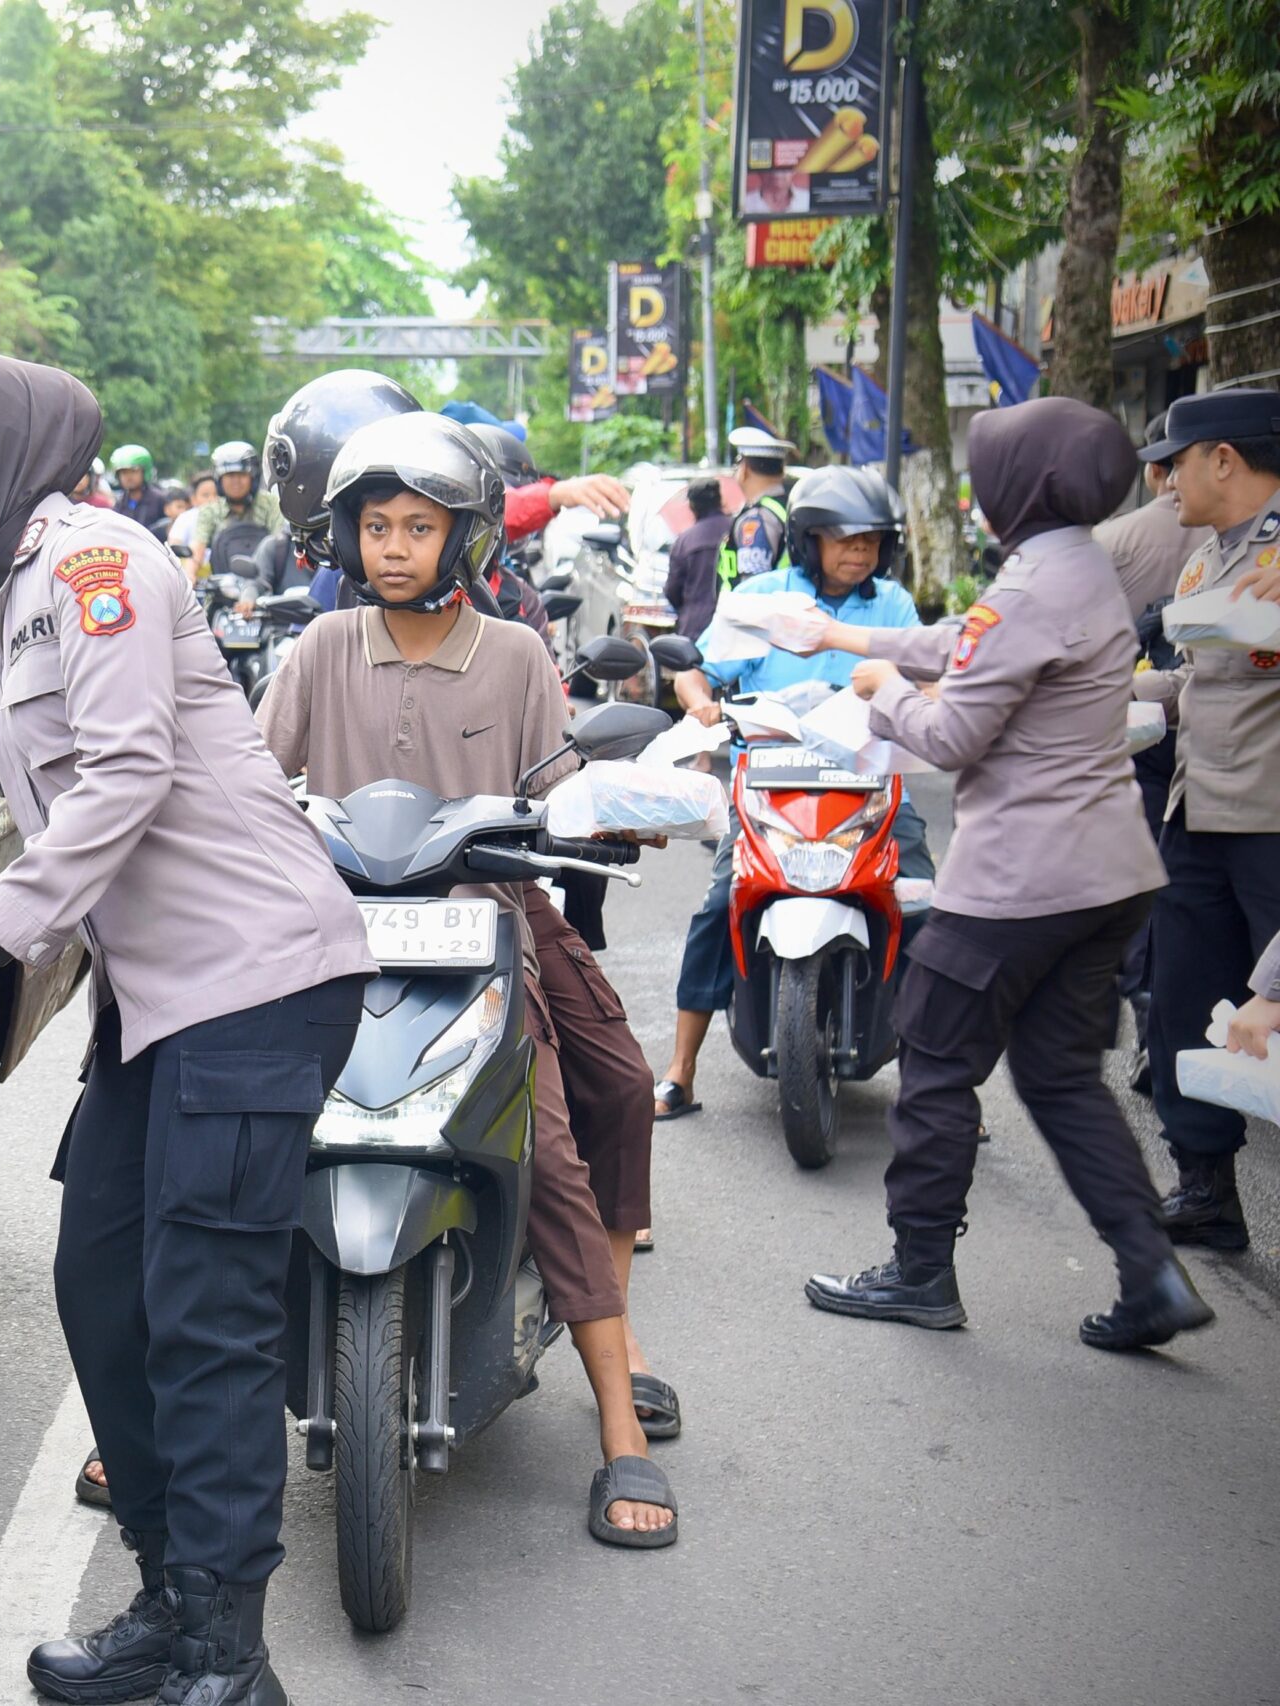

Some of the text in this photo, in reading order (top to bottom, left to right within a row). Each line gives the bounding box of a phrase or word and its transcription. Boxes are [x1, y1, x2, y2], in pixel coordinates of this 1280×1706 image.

[784, 0, 859, 73] D
[789, 77, 859, 104] 15.000
[629, 287, 666, 329] D
[60, 548, 122, 573] POLRES
[10, 613, 55, 658] POLRI
[369, 790, 417, 800] HONDA
[444, 907, 483, 929] BY
